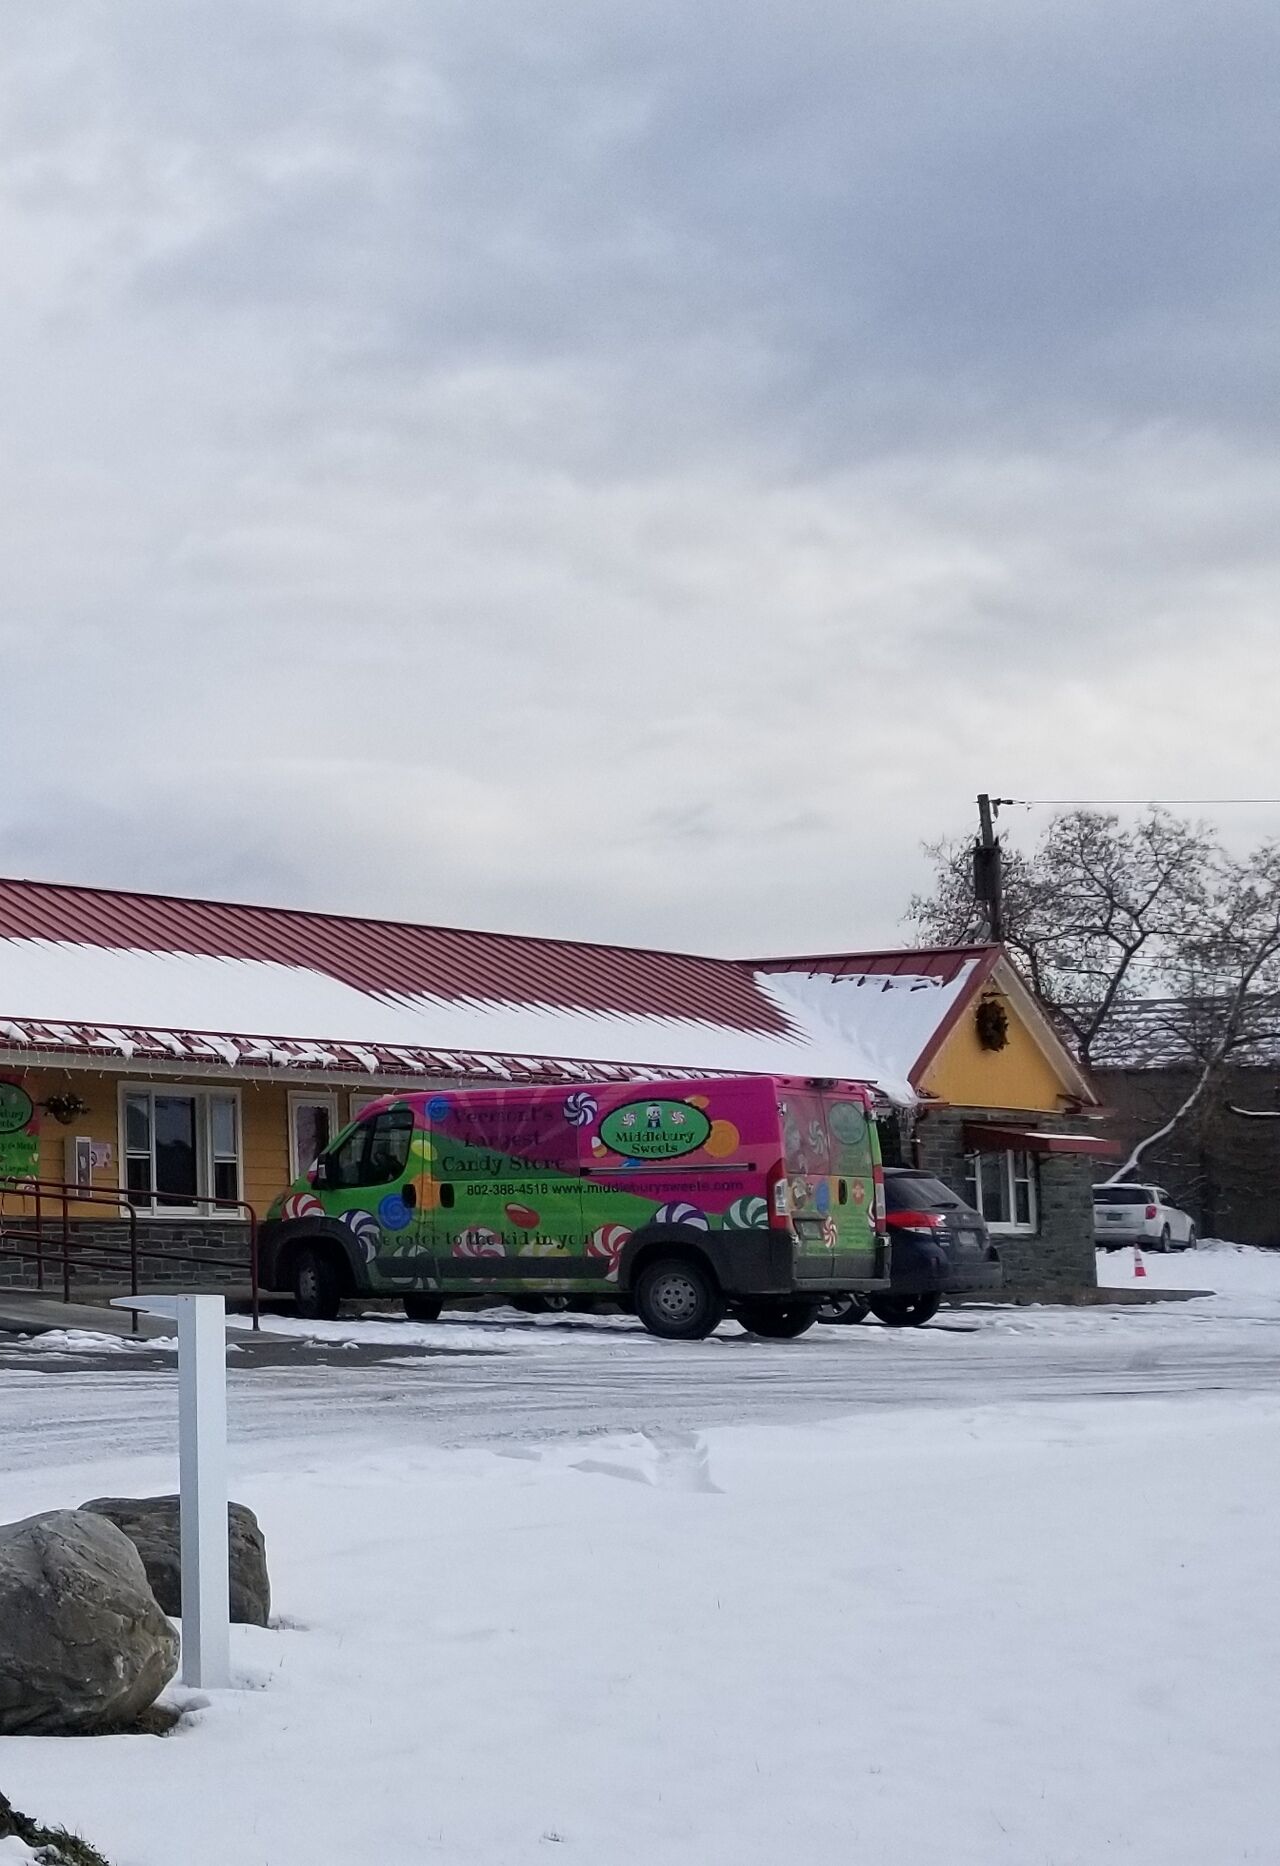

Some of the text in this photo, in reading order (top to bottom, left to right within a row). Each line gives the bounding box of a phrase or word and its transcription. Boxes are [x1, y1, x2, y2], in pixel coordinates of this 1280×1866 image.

[615, 1130, 695, 1143] Middlebury
[631, 1142, 678, 1154] Sweets
[442, 1156, 565, 1175] Candy Store
[467, 1180, 744, 1196] 802-388-4518 www.middleburysweets.com
[446, 1232, 463, 1245] to
[466, 1231, 495, 1246] the
[501, 1231, 531, 1246] kid
[536, 1231, 554, 1246] in
